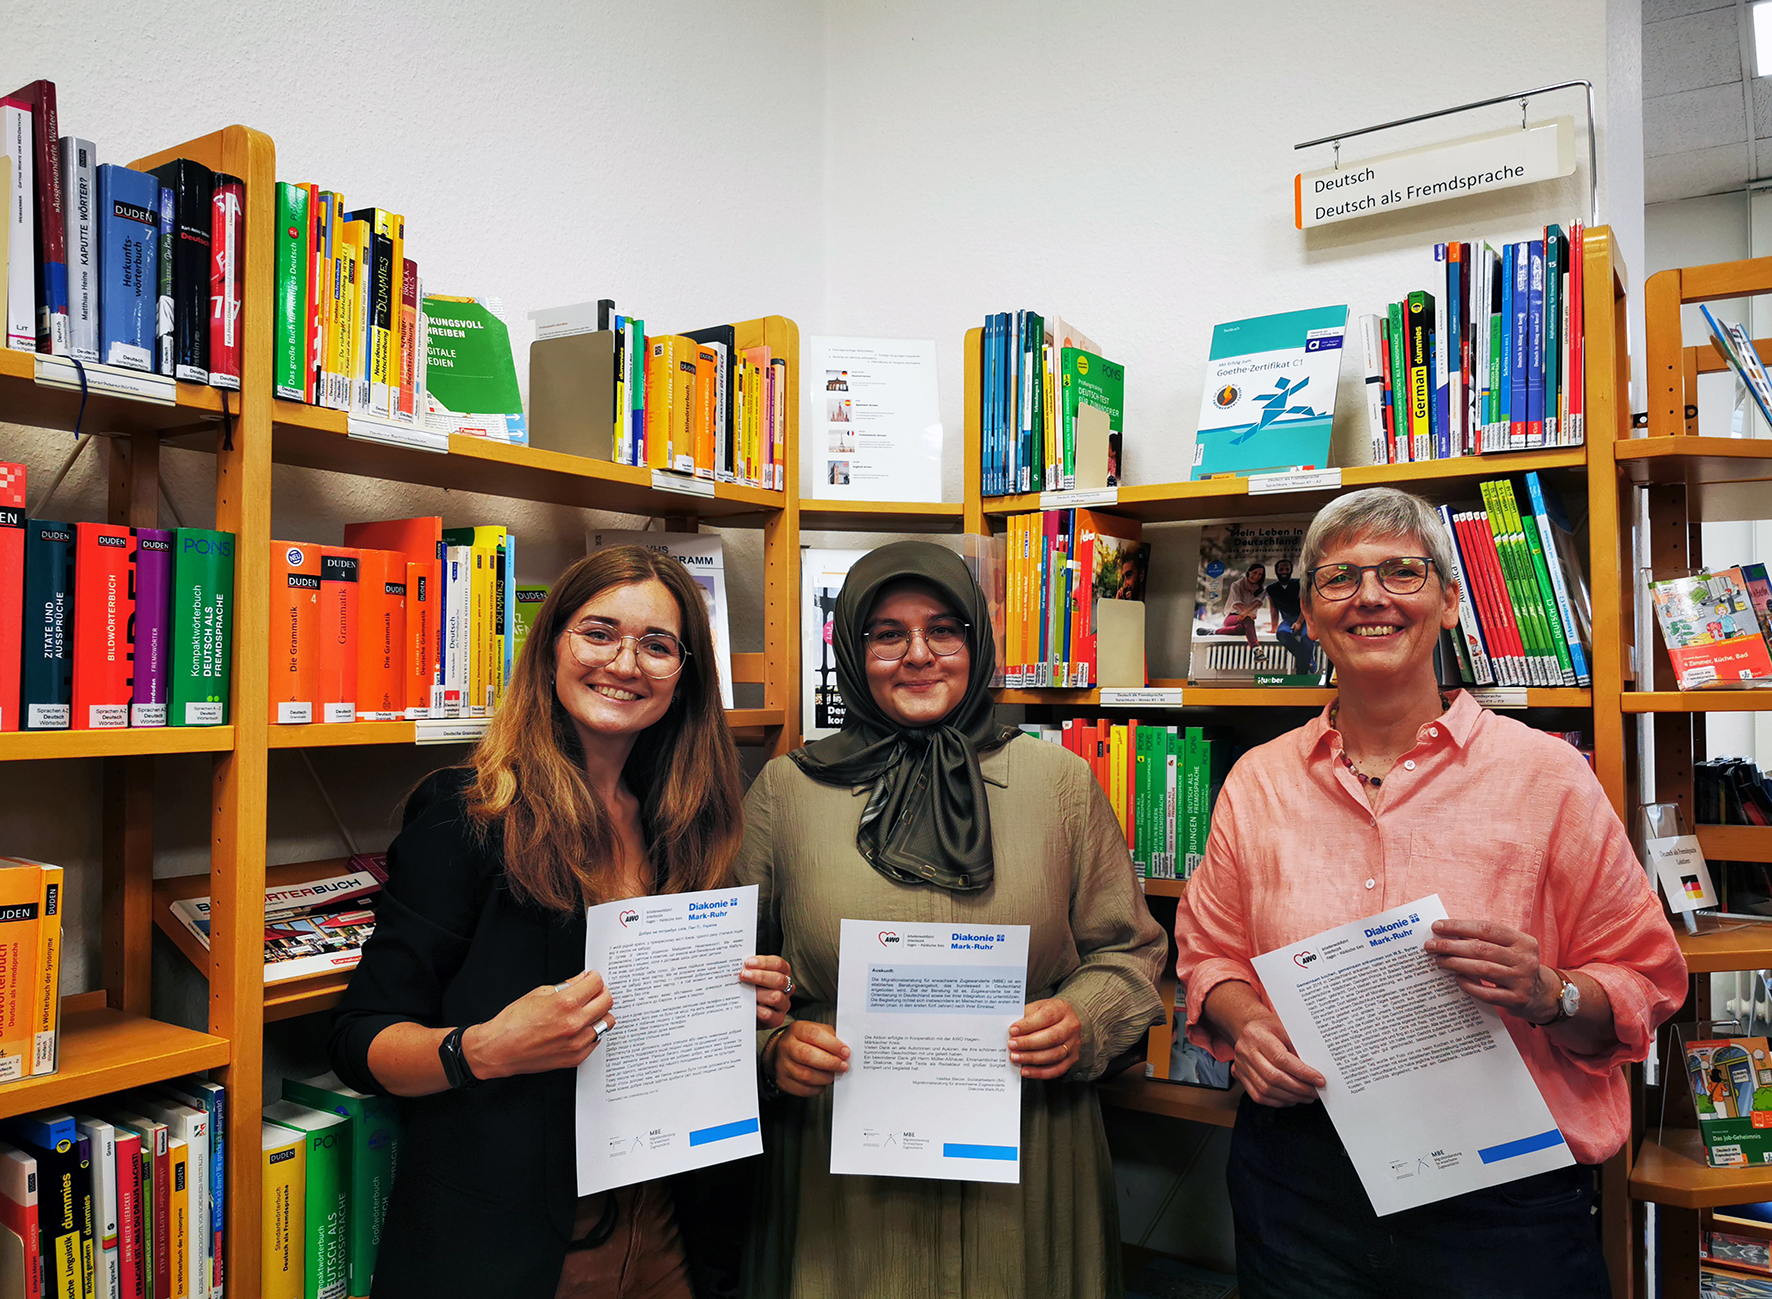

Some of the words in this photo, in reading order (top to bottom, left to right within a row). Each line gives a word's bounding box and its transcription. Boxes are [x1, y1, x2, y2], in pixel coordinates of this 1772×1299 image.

[1314, 167, 1375, 193] Deutsch
[79, 177, 88, 220] WÖRTER?
[1316, 196, 1376, 220] Deutsch
[1381, 191, 1402, 205] als
[1407, 164, 1524, 200] Fremdsprache
[115, 205, 152, 223] DUDEN
[80, 224, 88, 265] KAPUTTE
[144, 229, 153, 240] 7
[181, 232, 209, 247] Deutsch
[123, 235, 133, 287] Herkunfts-
[290, 242, 298, 274] Deutsch
[131, 242, 143, 297] wörterbuch
[289, 276, 298, 310] richtiges
[377, 256, 389, 312] DUMMIES
[427, 327, 465, 338] HREIBEN
[428, 316, 483, 329] KUNGSVOLL
[428, 346, 457, 358] GITALE
[1414, 326, 1423, 364] dummies
[288, 346, 298, 369] große
[381, 330, 390, 384] Rechtschreibung
[1217, 361, 1290, 377] Goethe-Zertifikat
[1293, 359, 1304, 367] C1
[1102, 363, 1122, 382] PONS
[1414, 369, 1426, 419] German
[41, 531, 70, 540] DUDEN
[99, 536, 126, 546] DUDEN
[1231, 529, 1255, 537] Mein
[1234, 537, 1298, 546] Deutschland
[1526, 524, 1537, 544] PONS
[143, 540, 169, 550] DUDEN
[184, 538, 231, 556] PONS
[646, 545, 668, 554] VHS
[289, 553, 301, 561] NEU
[327, 559, 356, 568] DUDEN
[674, 556, 714, 566] GRAMM
[288, 577, 317, 588] DUDEN
[311, 594, 316, 604] 4
[517, 591, 547, 600] DUDEN
[44, 601, 53, 624] UND
[107, 574, 116, 661] BILDWÖRTERBUCH
[203, 606, 212, 630] ALS
[338, 588, 347, 644] Grammatik
[1548, 608, 1562, 639] DEUTSCH
[55, 592, 64, 658] AUSSPRÜCHE
[191, 585, 201, 677] Kompaktwörterbuch
[214, 594, 224, 677] FREMDSPRACHE
[44, 627, 53, 658] ZITATE
[203, 633, 212, 677] DEUTSCH
[1257, 676, 1284, 685] Hueber
[1189, 816, 1197, 854] ÜBUNGEN
[0, 908, 30, 920] UDEN
[688, 910, 728, 921] Mark-Ruhr
[689, 900, 728, 911] Diakonie
[625, 914, 639, 922] AWO
[1364, 919, 1409, 938] Diakonie
[952, 933, 995, 942] Diakonie
[1369, 928, 1413, 947] Mark-Ruhr
[10, 942, 19, 987] Fremdsprache
[1302, 954, 1317, 964] AWO
[43, 984, 51, 1023] Wörterbuch
[271, 1150, 295, 1162] DUDEN
[61, 1173, 74, 1229] dummies
[372, 1176, 380, 1245] Großwörterbuch
[83, 1195, 92, 1235] dummies
[133, 1216, 140, 1227] DU
[328, 1212, 337, 1234] ALS
[64, 1236, 76, 1276] Linguistik
[84, 1244, 93, 1269] gendern
[327, 1241, 336, 1286] EUTSCH
[85, 1270, 93, 1294] Richtig
[134, 1261, 142, 1296] SPRACHE
